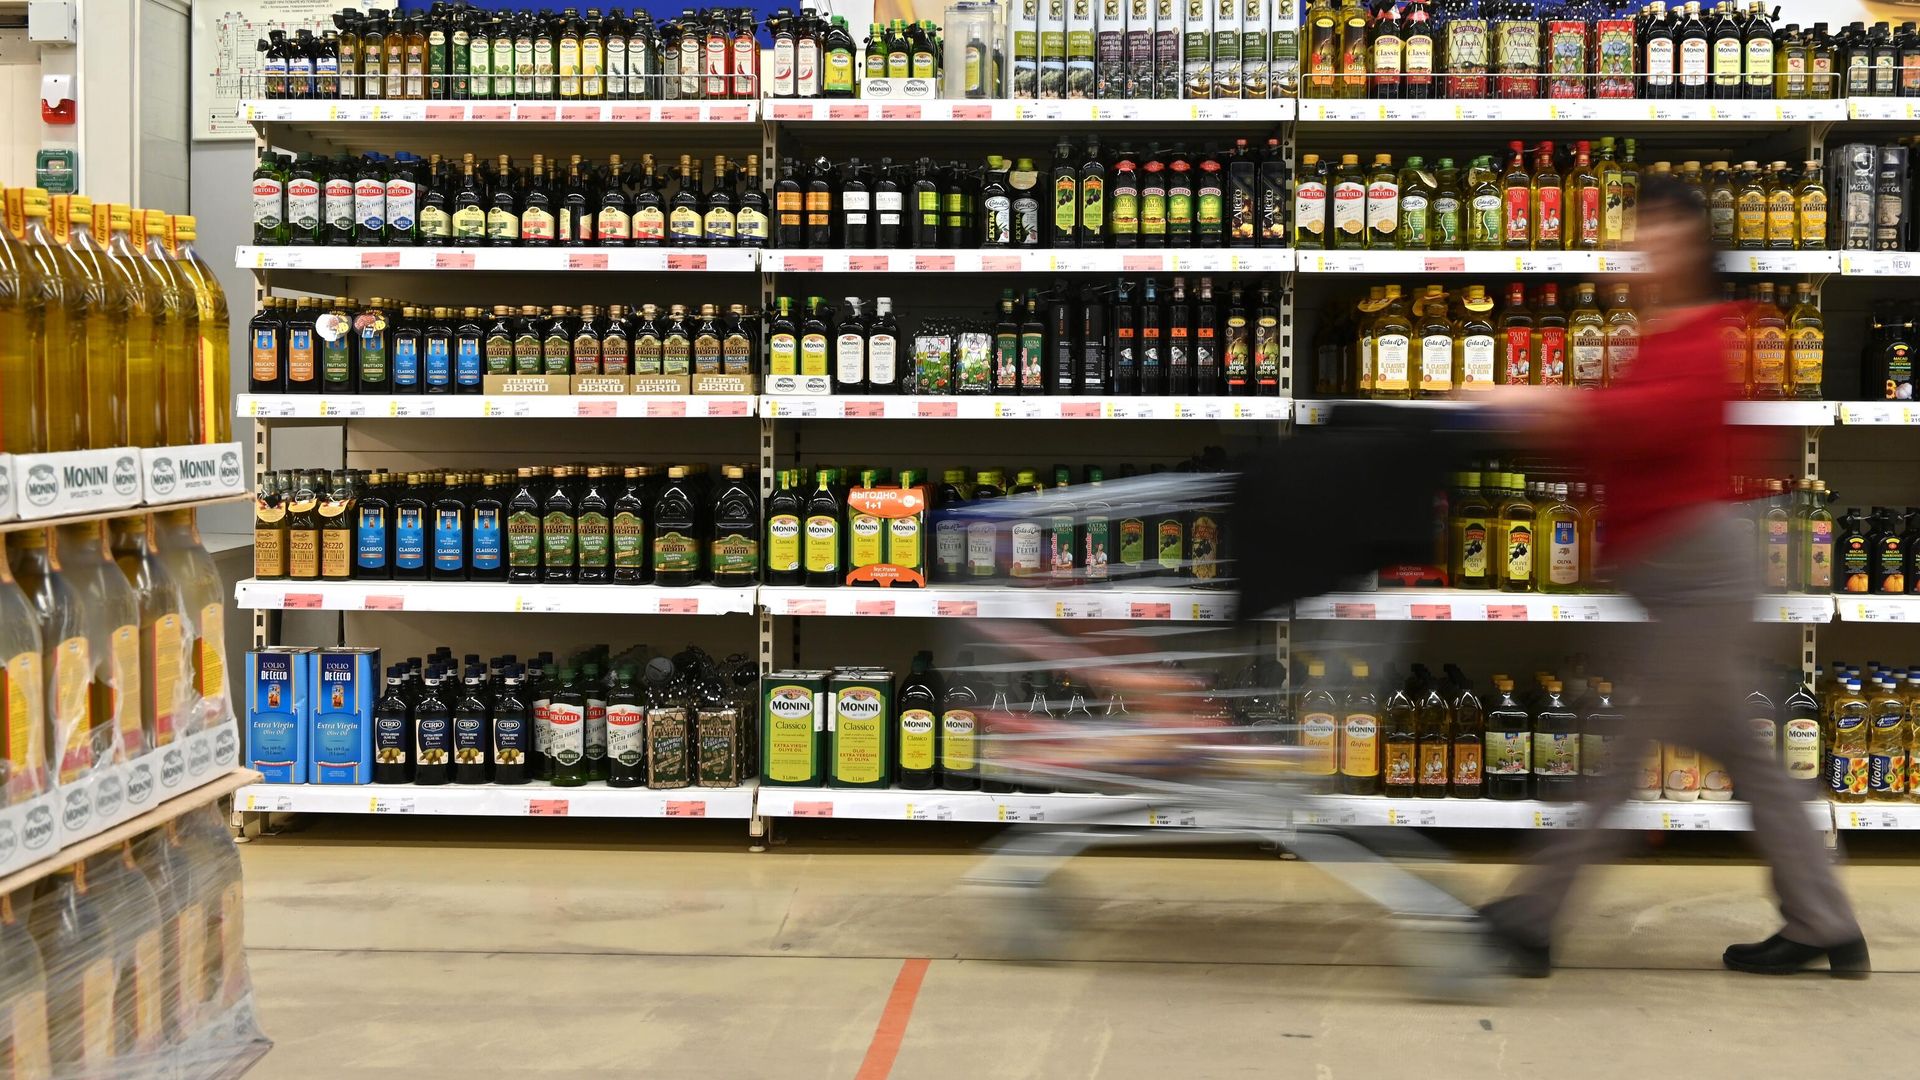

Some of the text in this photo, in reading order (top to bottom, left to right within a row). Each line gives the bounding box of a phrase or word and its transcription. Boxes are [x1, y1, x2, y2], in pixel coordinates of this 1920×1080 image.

[289, 187, 317, 195] BERTOLLI
[327, 187, 353, 195] BERTOLLI
[356, 187, 383, 195] BERTOLLI
[387, 187, 412, 195] BERTOLLI
[1369, 190, 1397, 198] BERTOLLI
[1234, 189, 1243, 221] Altero
[1264, 189, 1272, 221] Altero
[1893, 261, 1911, 269] NEW
[1379, 338, 1408, 347] Costa d'Oro
[1424, 338, 1438, 347] Costa
[1466, 339, 1479, 348] Costa
[502, 384, 549, 393] BERIO
[578, 384, 624, 393] BERIO
[636, 384, 680, 393] BERIO
[698, 384, 745, 392] BERIO
[180, 460, 216, 479] MONINI
[221, 467, 239, 478] MONINI
[64, 466, 109, 489] MONINI
[116, 474, 136, 486] MONINI
[153, 474, 175, 486] MONINI
[28, 483, 57, 497] MONINI
[851, 492, 897, 500] ВЫГОДНО
[808, 526, 834, 534] MONINI
[855, 524, 878, 532] MONINI
[893, 524, 916, 532] MONINI
[939, 543, 962, 551] L'EXTRA
[970, 544, 993, 553] L'EXTRA
[1016, 546, 1039, 554] L'EXTRA
[262, 671, 288, 681] DE CECCO
[325, 672, 351, 682] DE CECCO
[773, 701, 810, 710] MONINI
[841, 702, 878, 712] MONINI
[608, 714, 641, 723] BERTOLLI
[1877, 718, 1884, 727] 4
[273, 722, 294, 731] Virgin
[318, 722, 358, 731] Extra Virgin
[776, 721, 807, 730] Classico
[844, 722, 875, 731] Classico
[904, 721, 931, 729] MONINI
[1839, 719, 1845, 728] 4
[1348, 726, 1376, 734] MONINI
[1788, 730, 1818, 738] MONINI
[1832, 759, 1841, 788] Violio
[1872, 758, 1882, 787] Violio
